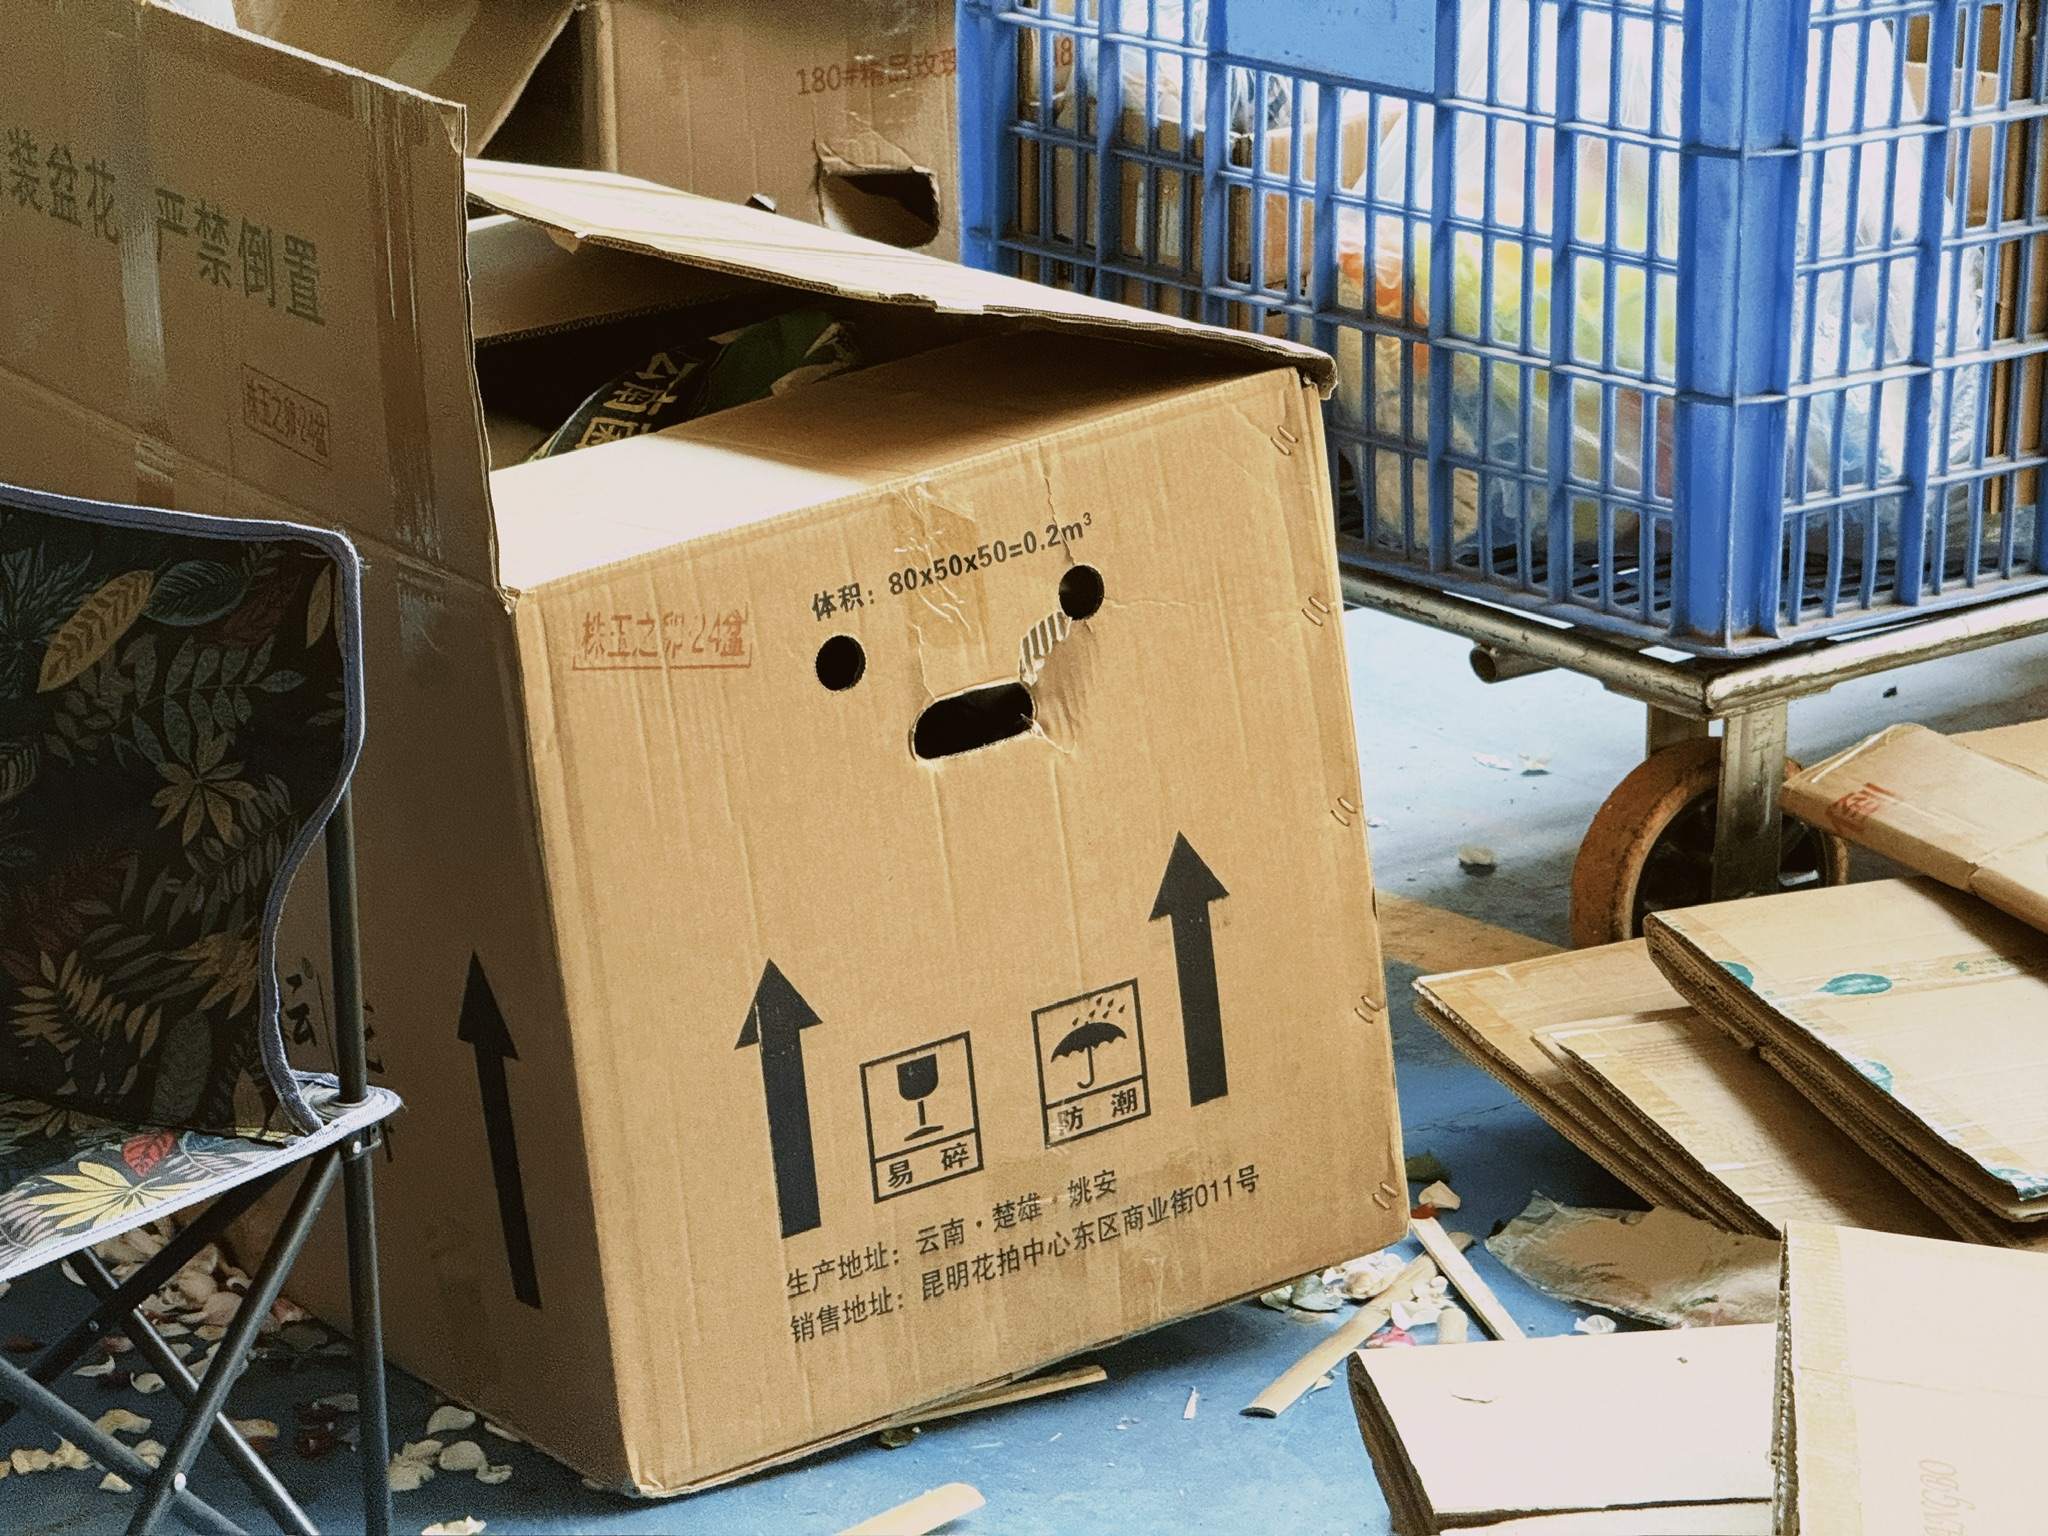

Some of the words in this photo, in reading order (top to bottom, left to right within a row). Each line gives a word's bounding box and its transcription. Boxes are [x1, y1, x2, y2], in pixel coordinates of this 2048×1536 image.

[0, 127, 119, 245] 装盆花
[154, 186, 326, 326] 严禁倒置
[1055, 1087, 1139, 1137] 防潮
[886, 1142, 970, 1189] 易碎
